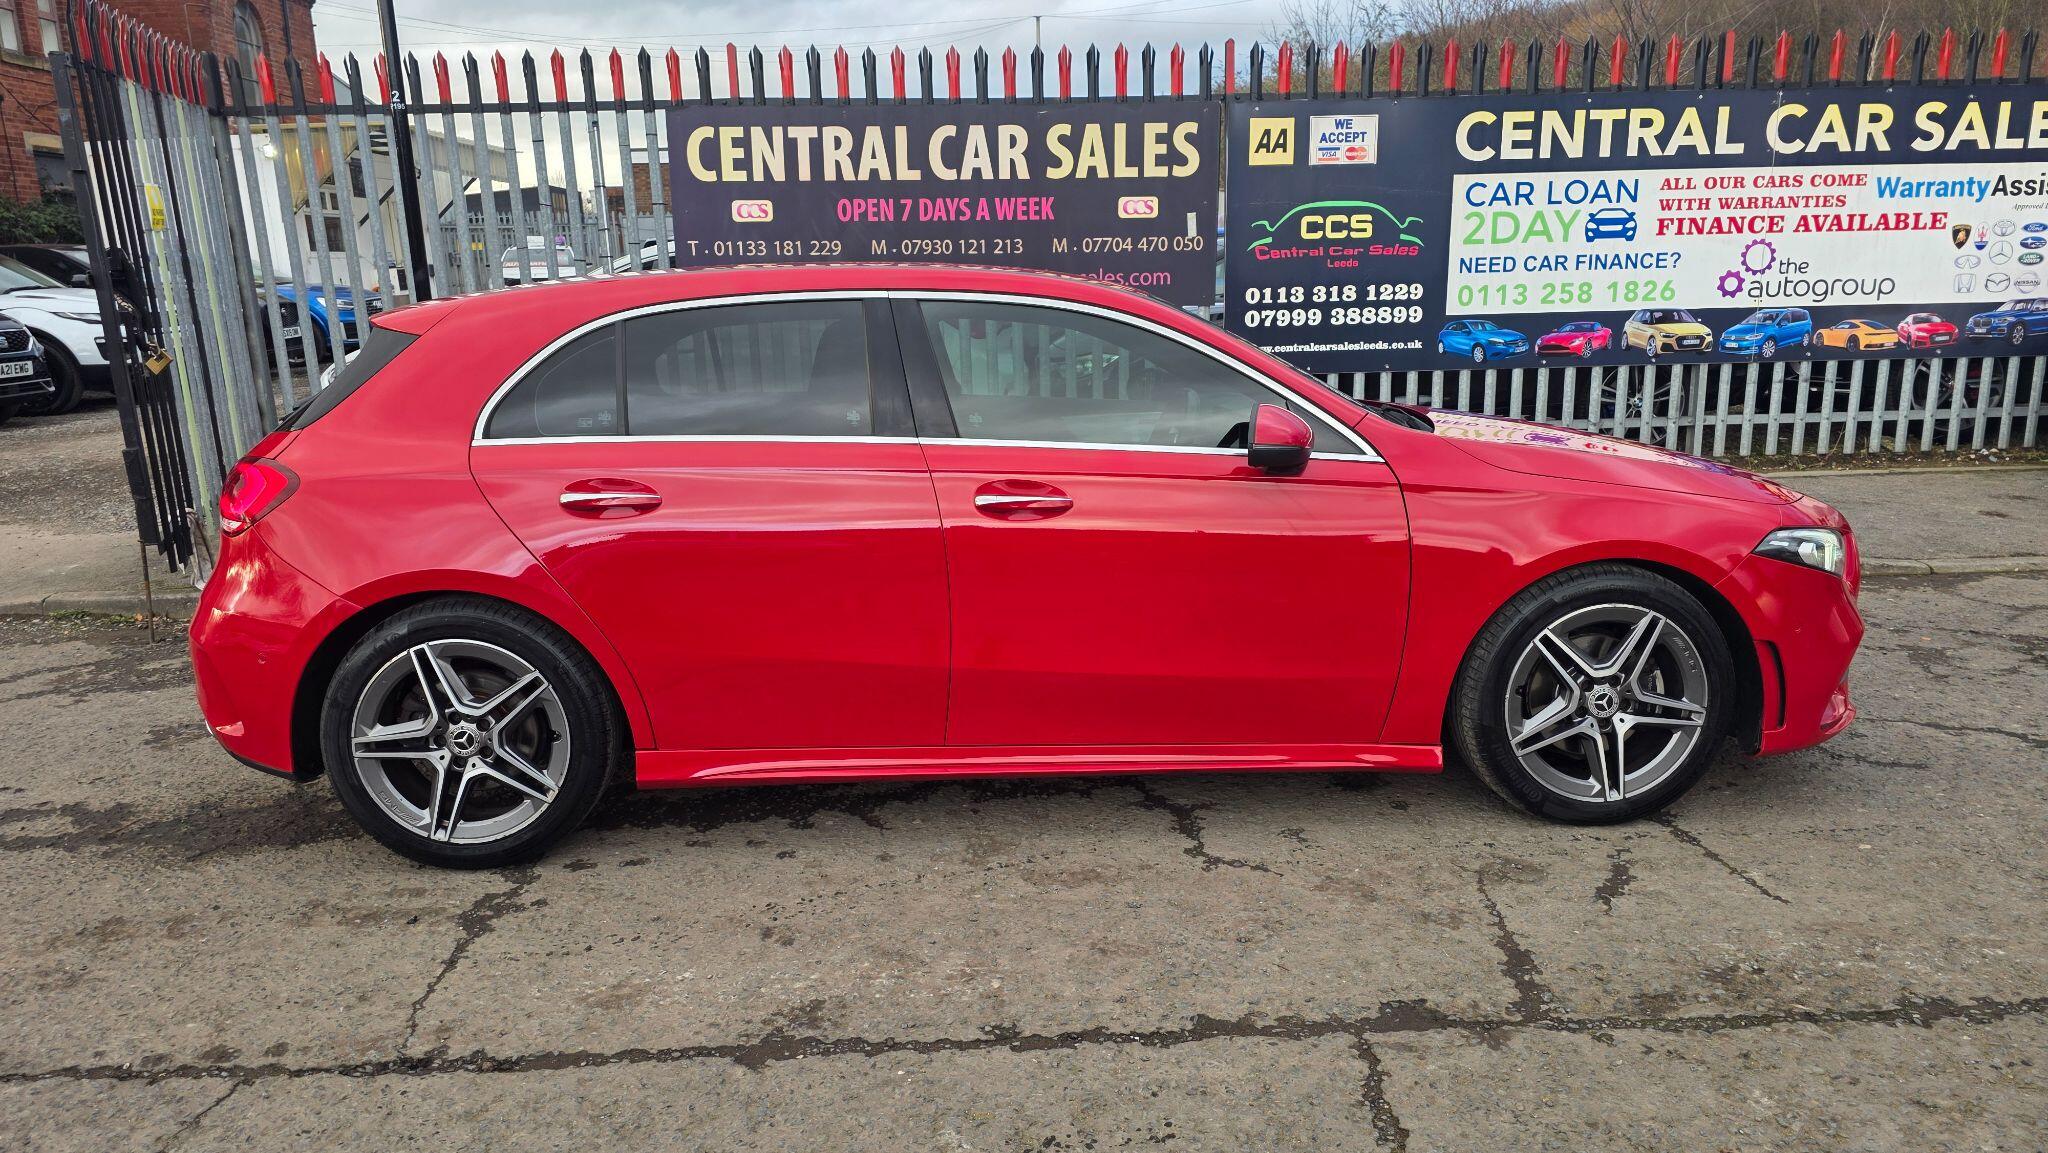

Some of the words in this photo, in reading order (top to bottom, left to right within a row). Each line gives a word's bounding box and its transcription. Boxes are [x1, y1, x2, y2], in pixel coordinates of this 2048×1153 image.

[391, 90, 400, 102] 2
[1334, 118, 1353, 130] WE
[1455, 105, 1745, 162] CENTRAL
[1766, 103, 1894, 154] CAR
[1254, 128, 1288, 154] AA
[1319, 131, 1367, 144] ACCEPT
[686, 125, 921, 182] CENTRAL
[928, 124, 1030, 181] CAR
[1046, 121, 1201, 179] SALES
[1465, 181, 1533, 207] CAR
[1548, 177, 1639, 206] LOAN
[1660, 176, 1696, 191] ALL
[1704, 175, 1746, 190] OUR
[1752, 174, 1804, 189] CARS
[1810, 173, 1868, 187] COME
[837, 199, 893, 223] OPEN
[898, 199, 911, 222] 7
[918, 197, 972, 222] DAYS
[975, 198, 991, 221] A
[994, 196, 1055, 221] WEEK
[1659, 198, 1711, 212] WITH
[1718, 194, 1847, 210] WARRANTIES
[2013, 203, 2045, 211] Approved
[1300, 214, 1373, 240] CCS
[1462, 209, 1582, 245] 2DAY
[1656, 215, 1785, 236] FINANCE
[1793, 211, 1949, 233] AVAILABLE
[714, 239, 767, 256] 01133
[774, 240, 801, 256] 181
[810, 239, 842, 256] 229
[902, 239, 951, 255] 07930
[959, 238, 985, 254] 121
[994, 238, 1023, 254] 213
[1083, 236, 1132, 254] 07704
[1138, 235, 1169, 252] 470
[1173, 235, 1203, 252] 050
[1255, 245, 1324, 261] Central
[1329, 246, 1363, 256] Car
[1369, 244, 1419, 257] Sales
[1327, 258, 1359, 268] Leeds
[1459, 257, 1516, 274] NEED
[1523, 255, 1568, 272] CAR
[1575, 251, 1682, 271] FINANCE?
[1779, 257, 1809, 275] the
[1245, 286, 1304, 304] 0113
[1313, 285, 1357, 302] 318
[1366, 283, 1424, 300] 1229
[1458, 284, 1528, 307] 0113
[1541, 281, 1592, 304] 258
[1607, 279, 1676, 304] 1826
[1748, 275, 1896, 303] autogroup
[1245, 308, 1322, 327] 07999
[1331, 306, 1423, 325] 388899
